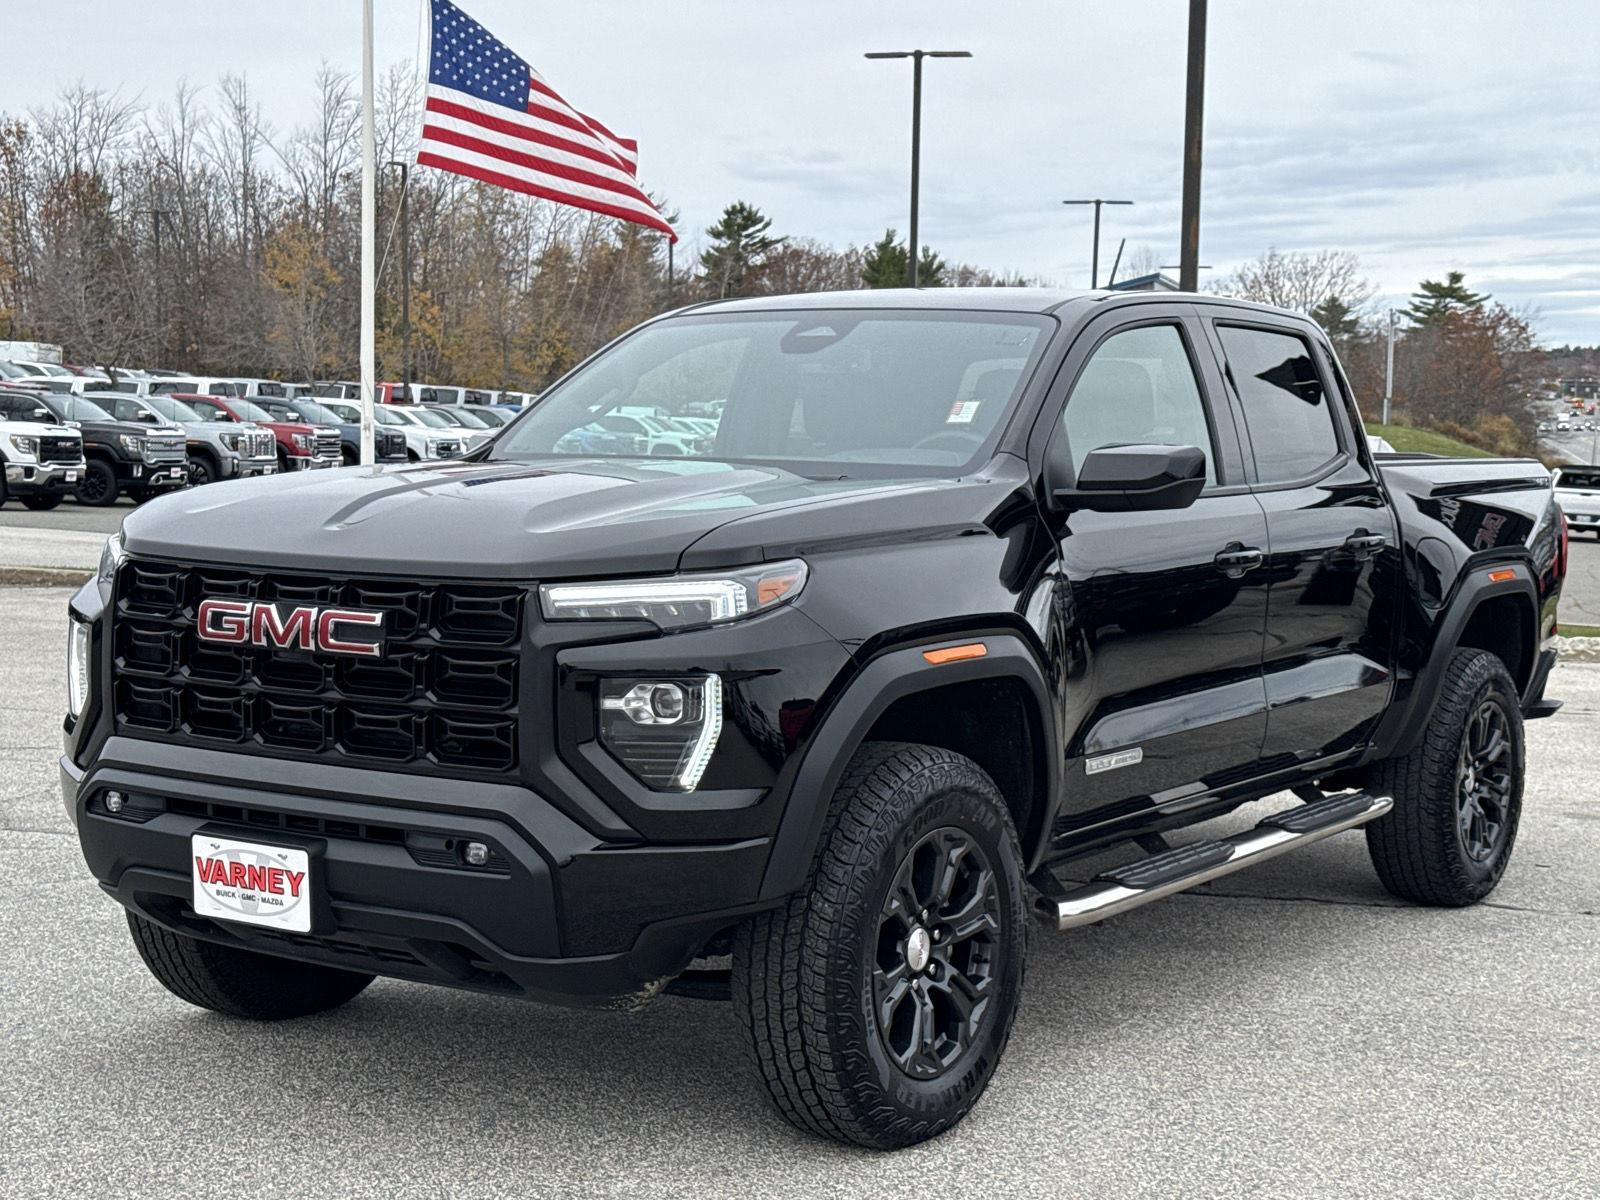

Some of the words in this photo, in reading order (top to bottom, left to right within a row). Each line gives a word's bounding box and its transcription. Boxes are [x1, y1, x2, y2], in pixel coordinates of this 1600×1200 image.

[197, 599, 383, 657] GMC
[903, 794, 996, 847] GOODAR
[195, 856, 306, 897] VARNEY
[216, 889, 236, 898] BUICK
[241, 893, 256, 902] GMC
[261, 896, 284, 906] MAZDA
[895, 1055, 988, 1112] WRANGLER
